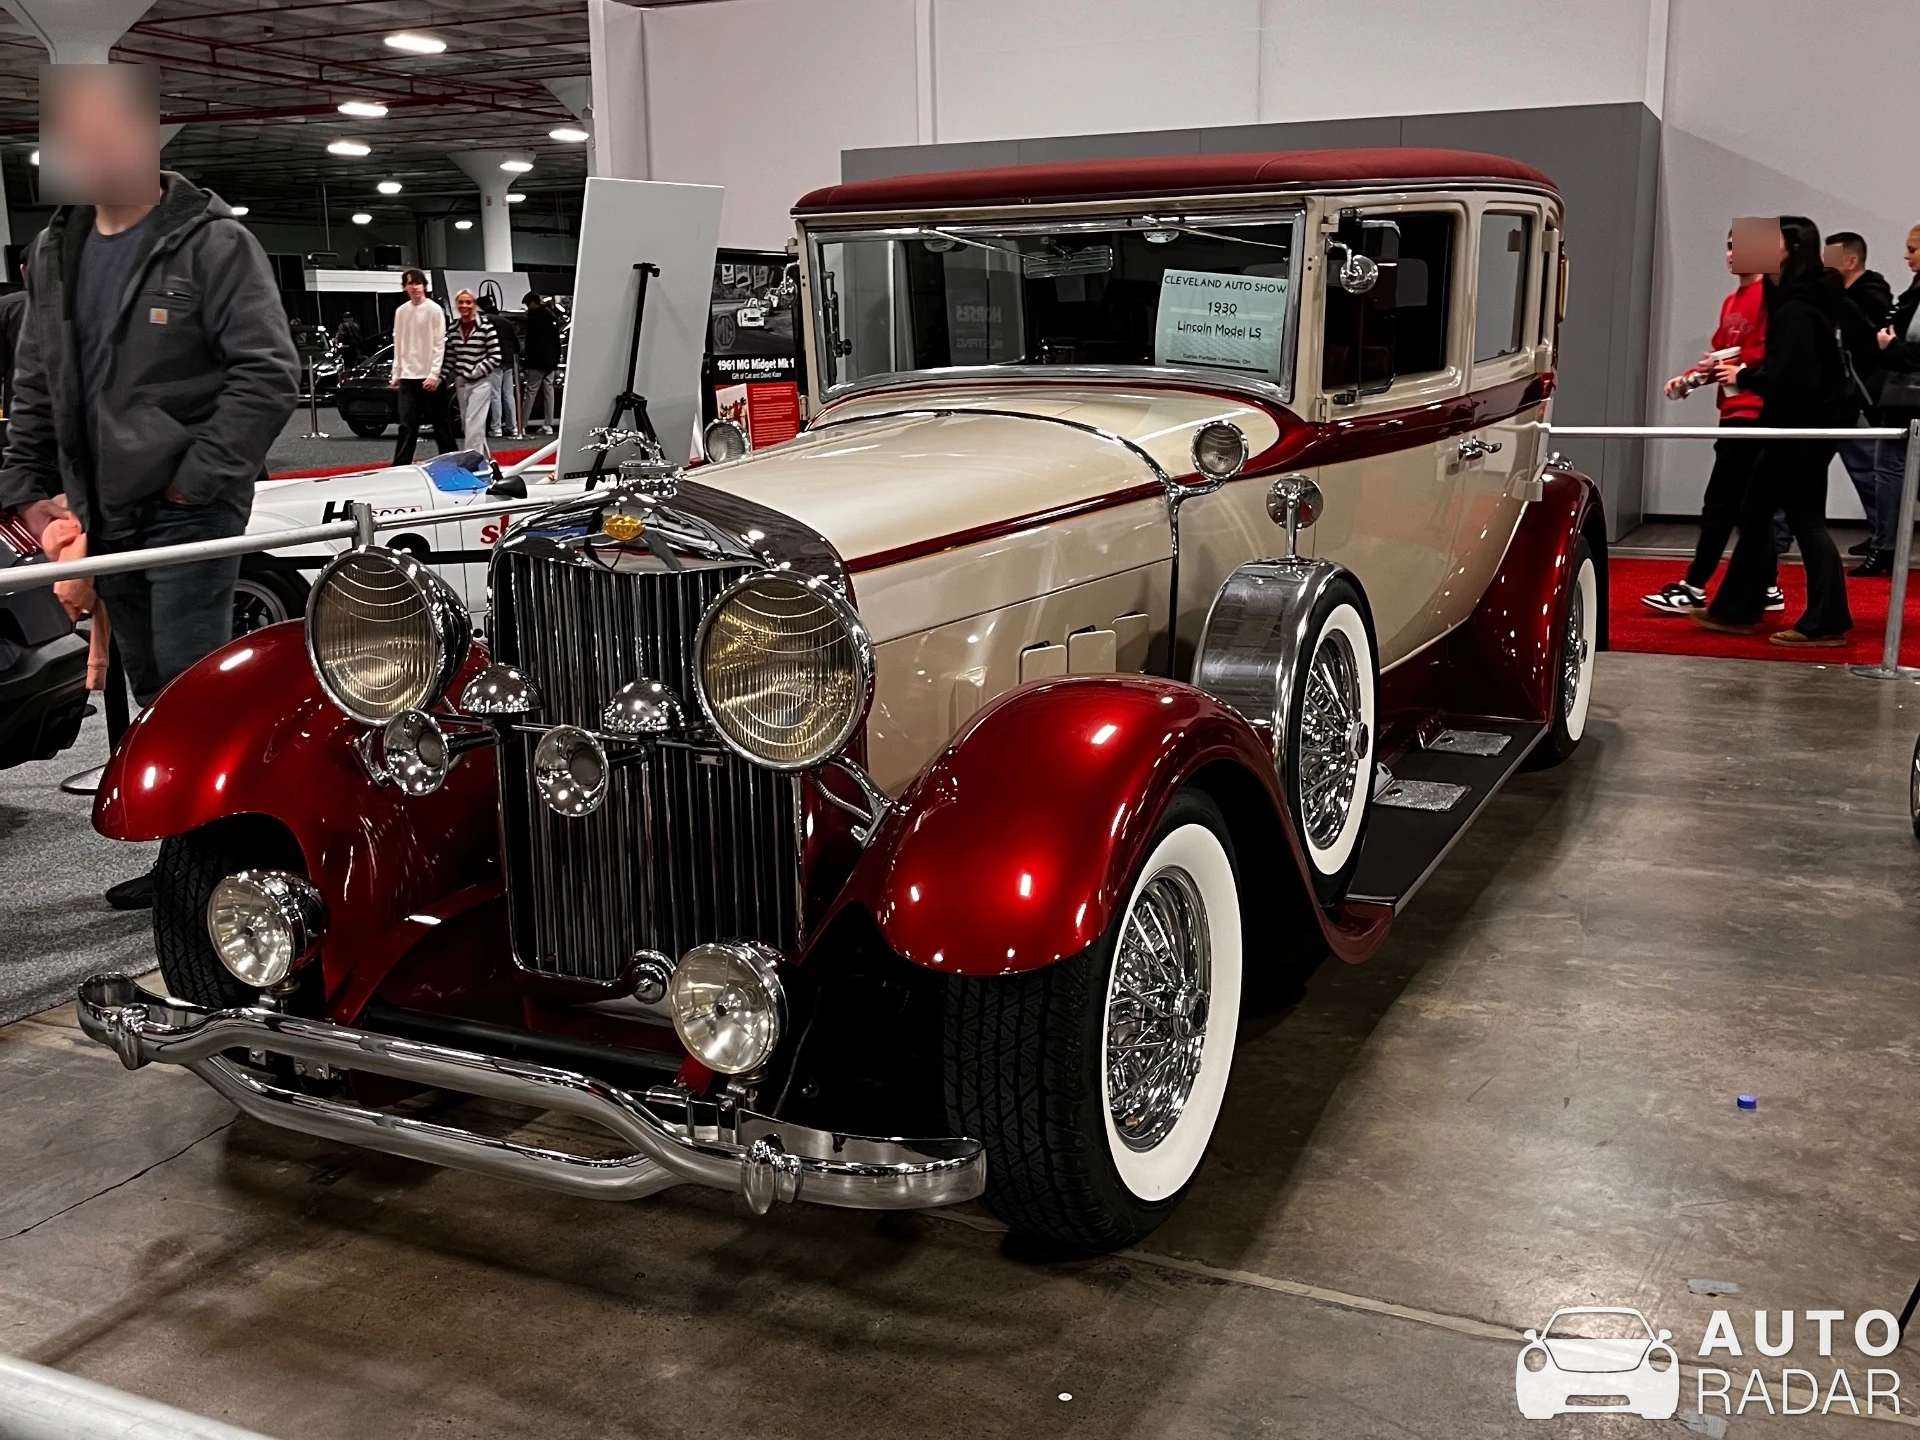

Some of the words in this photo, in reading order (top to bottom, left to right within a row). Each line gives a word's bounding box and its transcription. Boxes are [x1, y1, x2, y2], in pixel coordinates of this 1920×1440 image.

[1164, 275, 1222, 288] CLEVELAND
[1225, 280, 1252, 291] AUTO
[1254, 283, 1287, 294] SHOW
[1208, 301, 1238, 317] 1930
[1177, 320, 1212, 335] Lincoln
[1215, 324, 1246, 337] Model
[1249, 327, 1262, 340] LS
[717, 359, 735, 371] 1961
[737, 358, 750, 370] MG
[751, 357, 777, 372] Midget
[777, 357, 790, 369] Mk
[789, 357, 795, 369] 1
